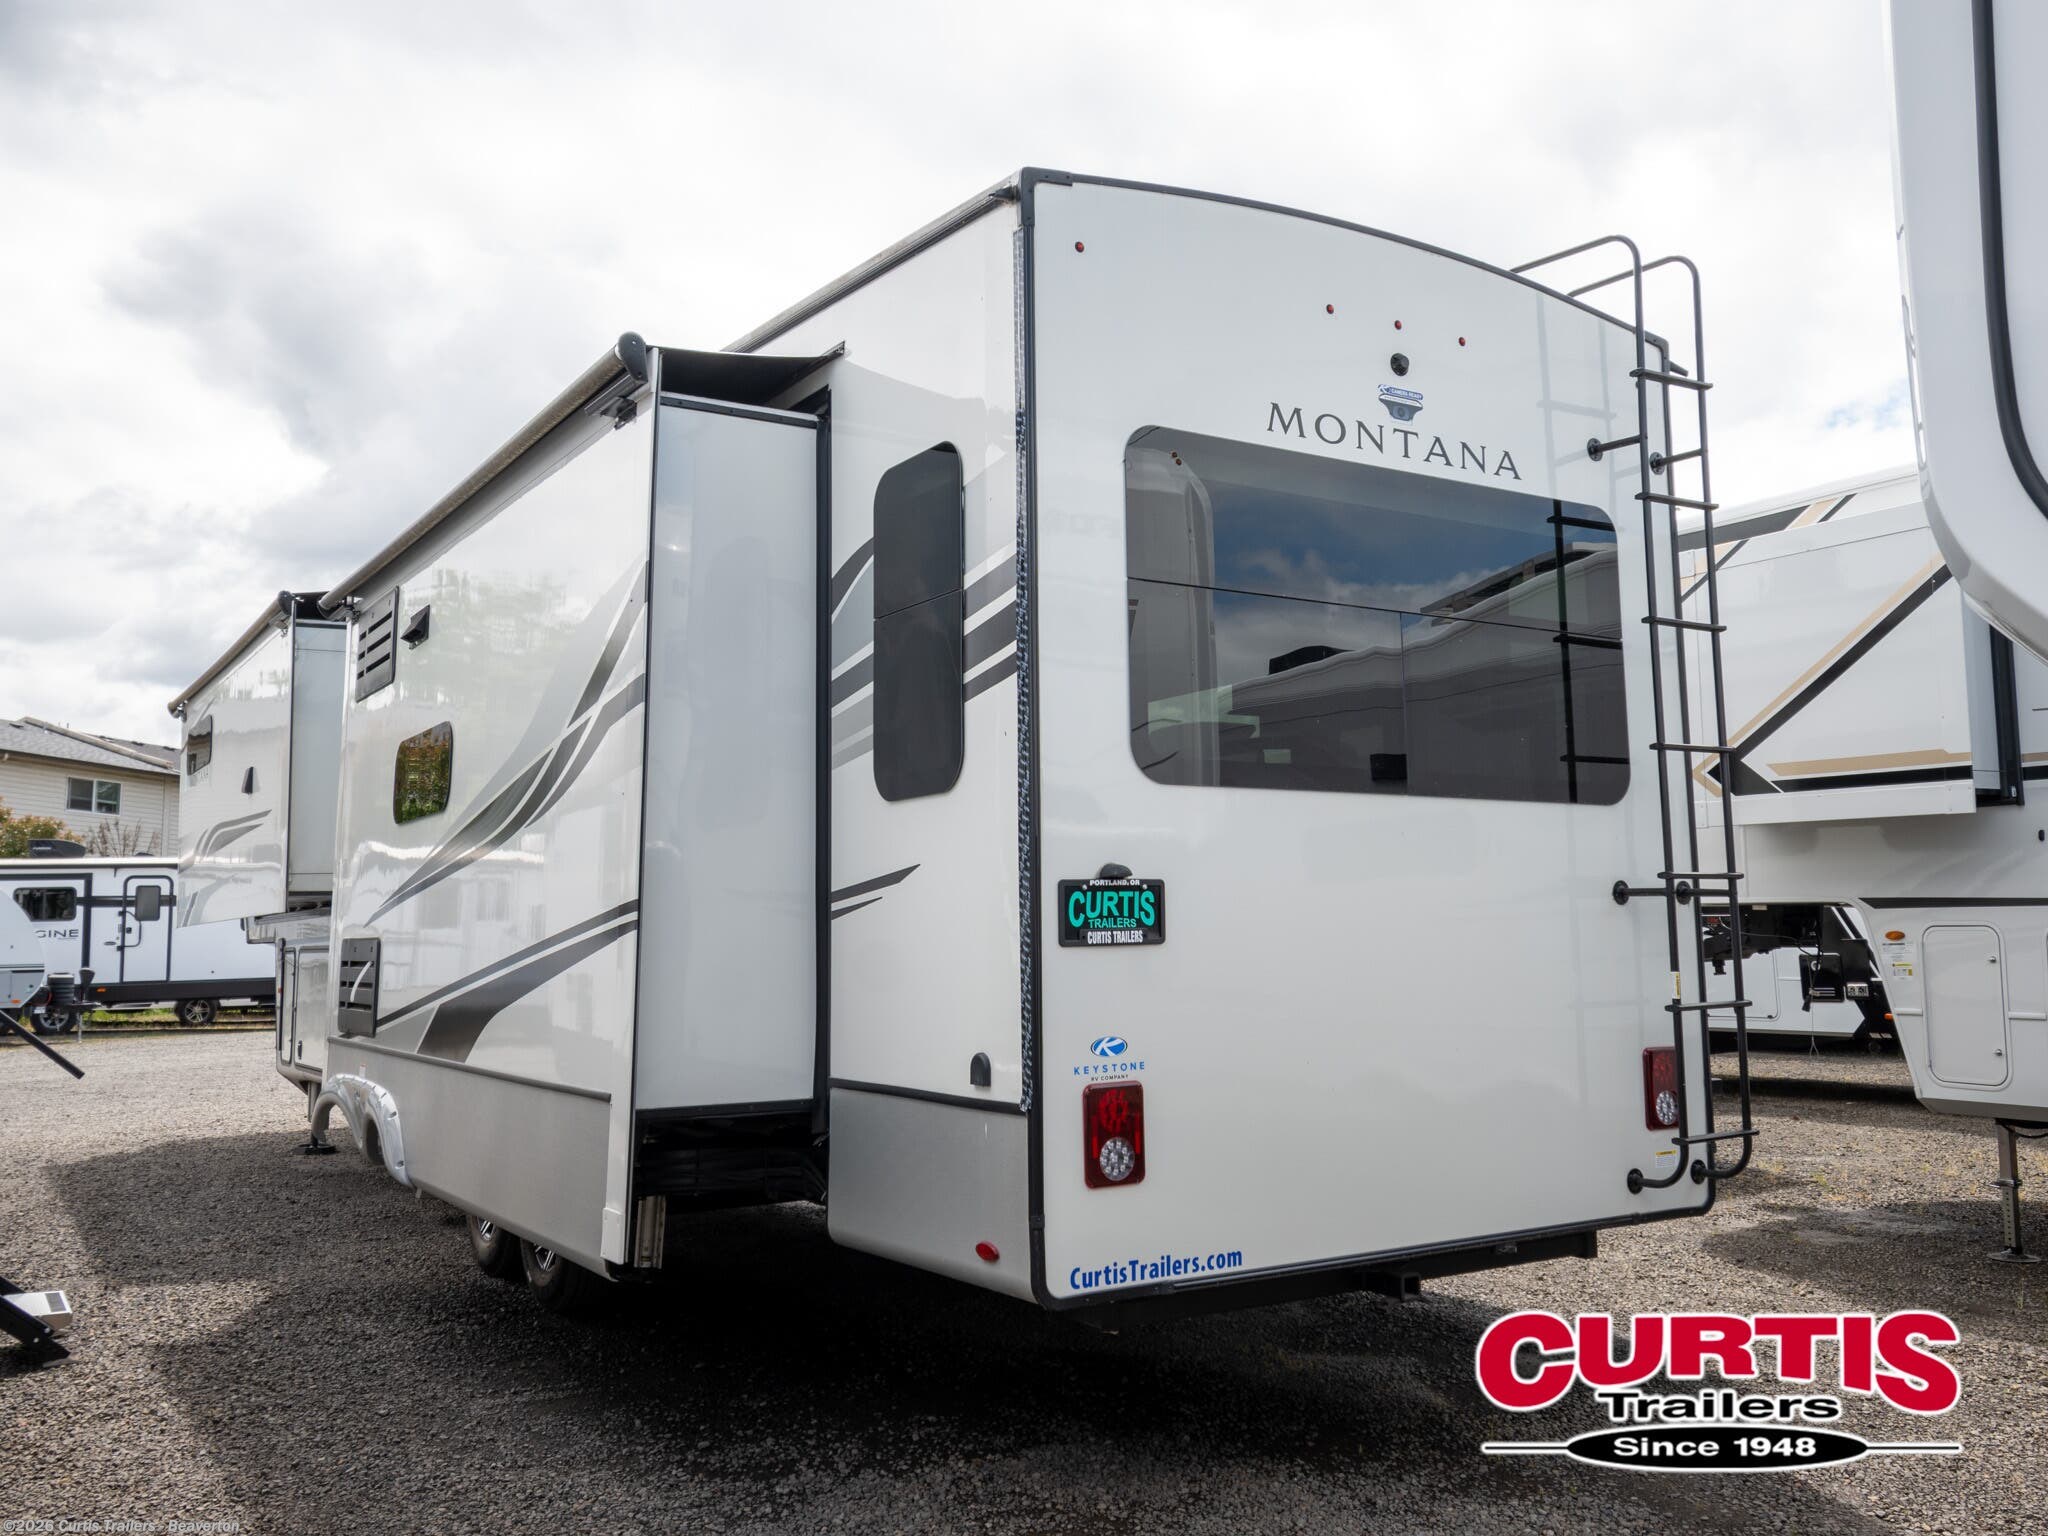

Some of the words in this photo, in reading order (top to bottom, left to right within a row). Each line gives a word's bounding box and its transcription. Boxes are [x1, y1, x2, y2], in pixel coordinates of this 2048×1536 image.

[1266, 401, 1523, 481] MONTANA
[1068, 890, 1156, 928] CURTIS
[1088, 917, 1137, 928] TRAILERS
[1087, 930, 1112, 945] CURTIS
[1113, 929, 1143, 943] TRAILERS
[1073, 1061, 1145, 1076] KEYSTONE
[1070, 1250, 1243, 1290] CurtisTrailers.com
